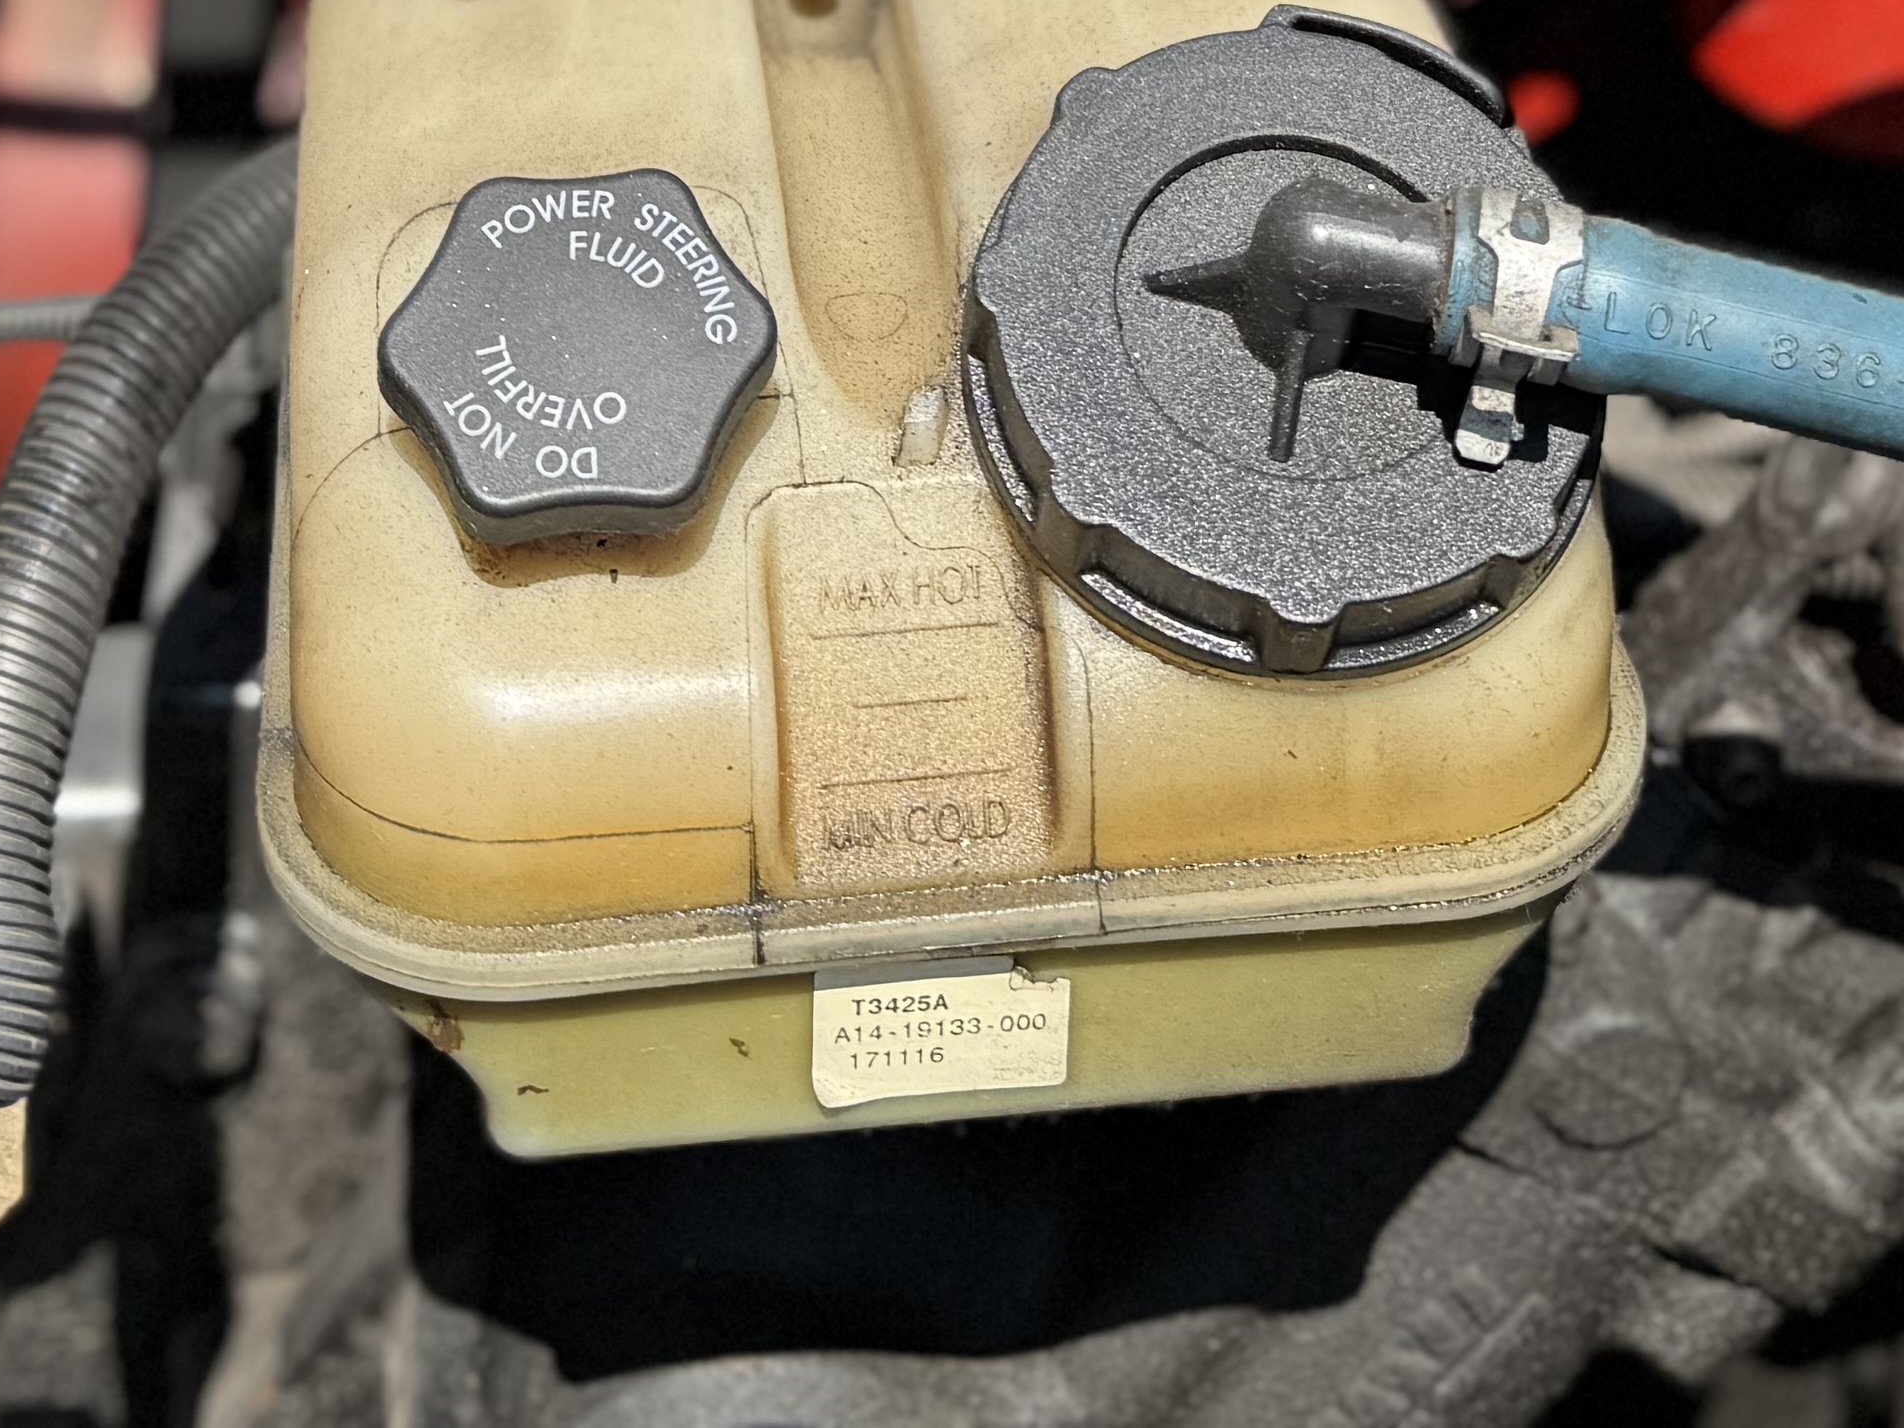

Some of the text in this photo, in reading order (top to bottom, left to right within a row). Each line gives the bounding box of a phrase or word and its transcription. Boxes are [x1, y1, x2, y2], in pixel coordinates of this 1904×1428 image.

[481, 189, 738, 345] POWER STEERING
[569, 230, 666, 289] FLUID
[476, 334, 628, 430] OVERFILL
[444, 392, 598, 479] DO NOT
[819, 563, 982, 615] MAX HOT
[823, 799, 1012, 852] MIN COLD
[834, 1012, 1047, 1045] A14-19133-000
[851, 993, 949, 1017] T3425A
[849, 1046, 945, 1070] 171116
